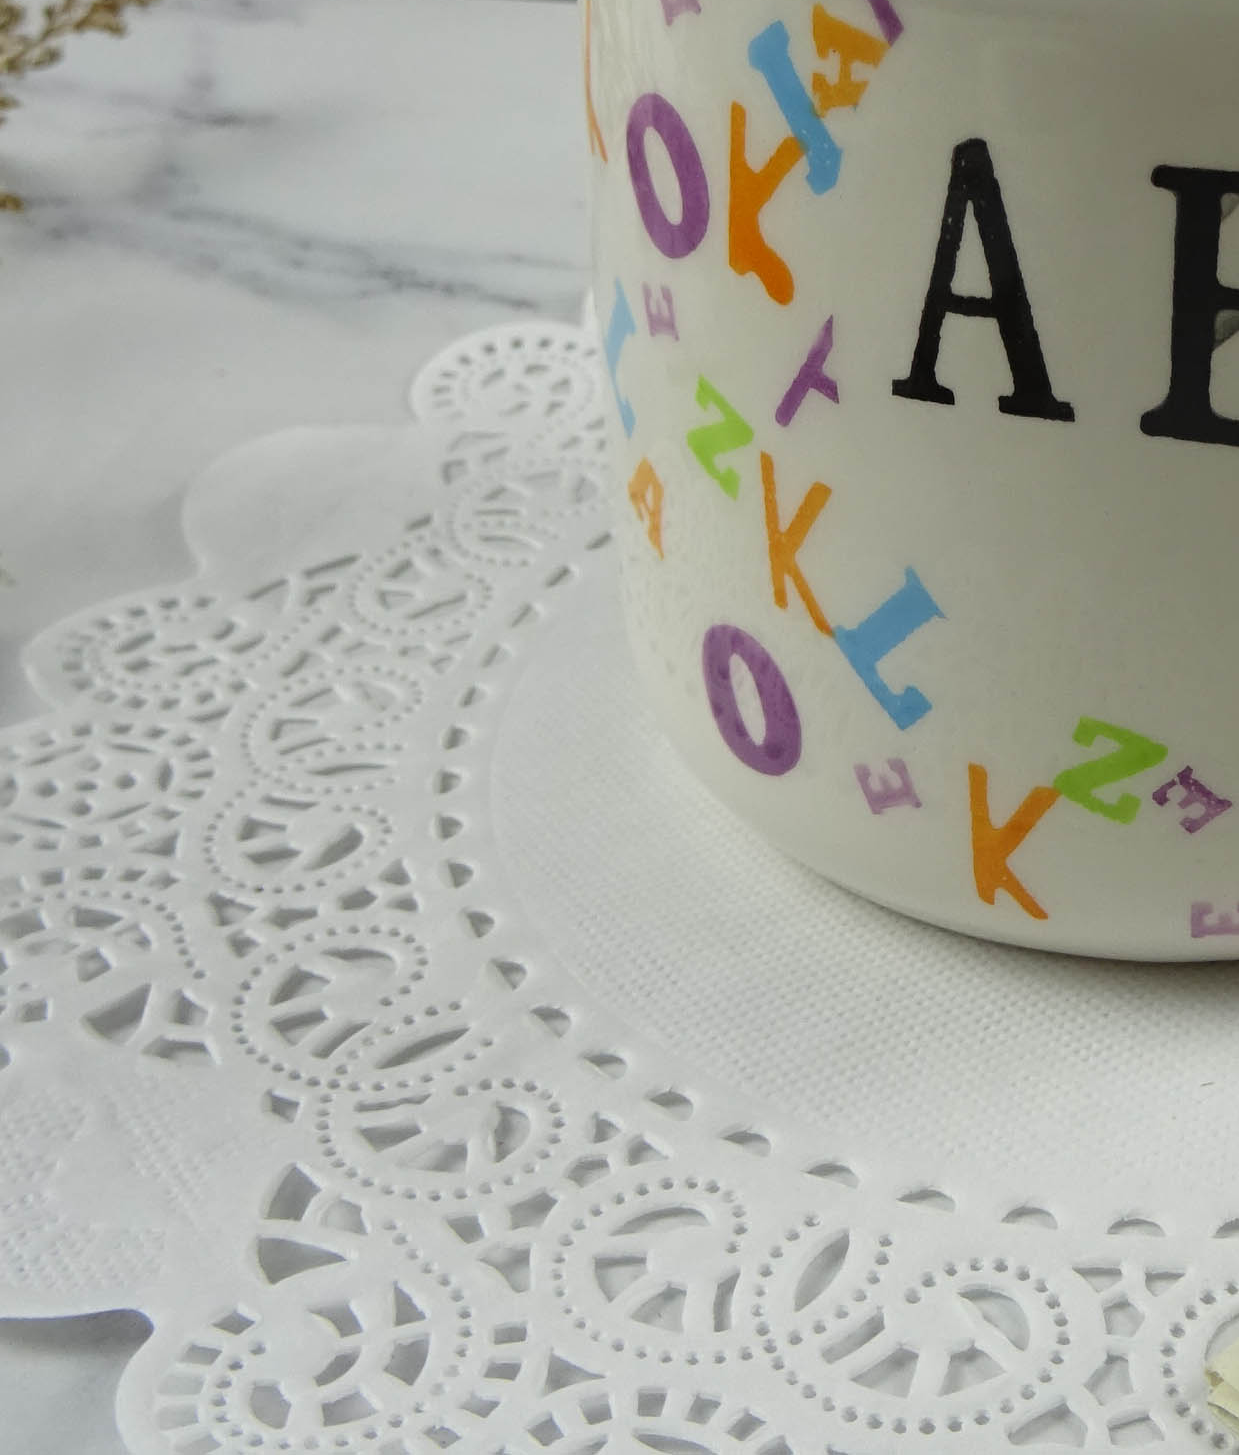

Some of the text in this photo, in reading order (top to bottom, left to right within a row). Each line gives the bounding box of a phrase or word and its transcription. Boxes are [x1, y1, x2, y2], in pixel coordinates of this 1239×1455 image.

[626, 92, 711, 261] O
[727, 100, 806, 307] K
[685, 372, 756, 502] Z
[760, 450, 834, 637] K
[702, 623, 803, 777] O
[832, 565, 947, 732] L
[967, 762, 1064, 921] K
[1052, 715, 1170, 826] Z
